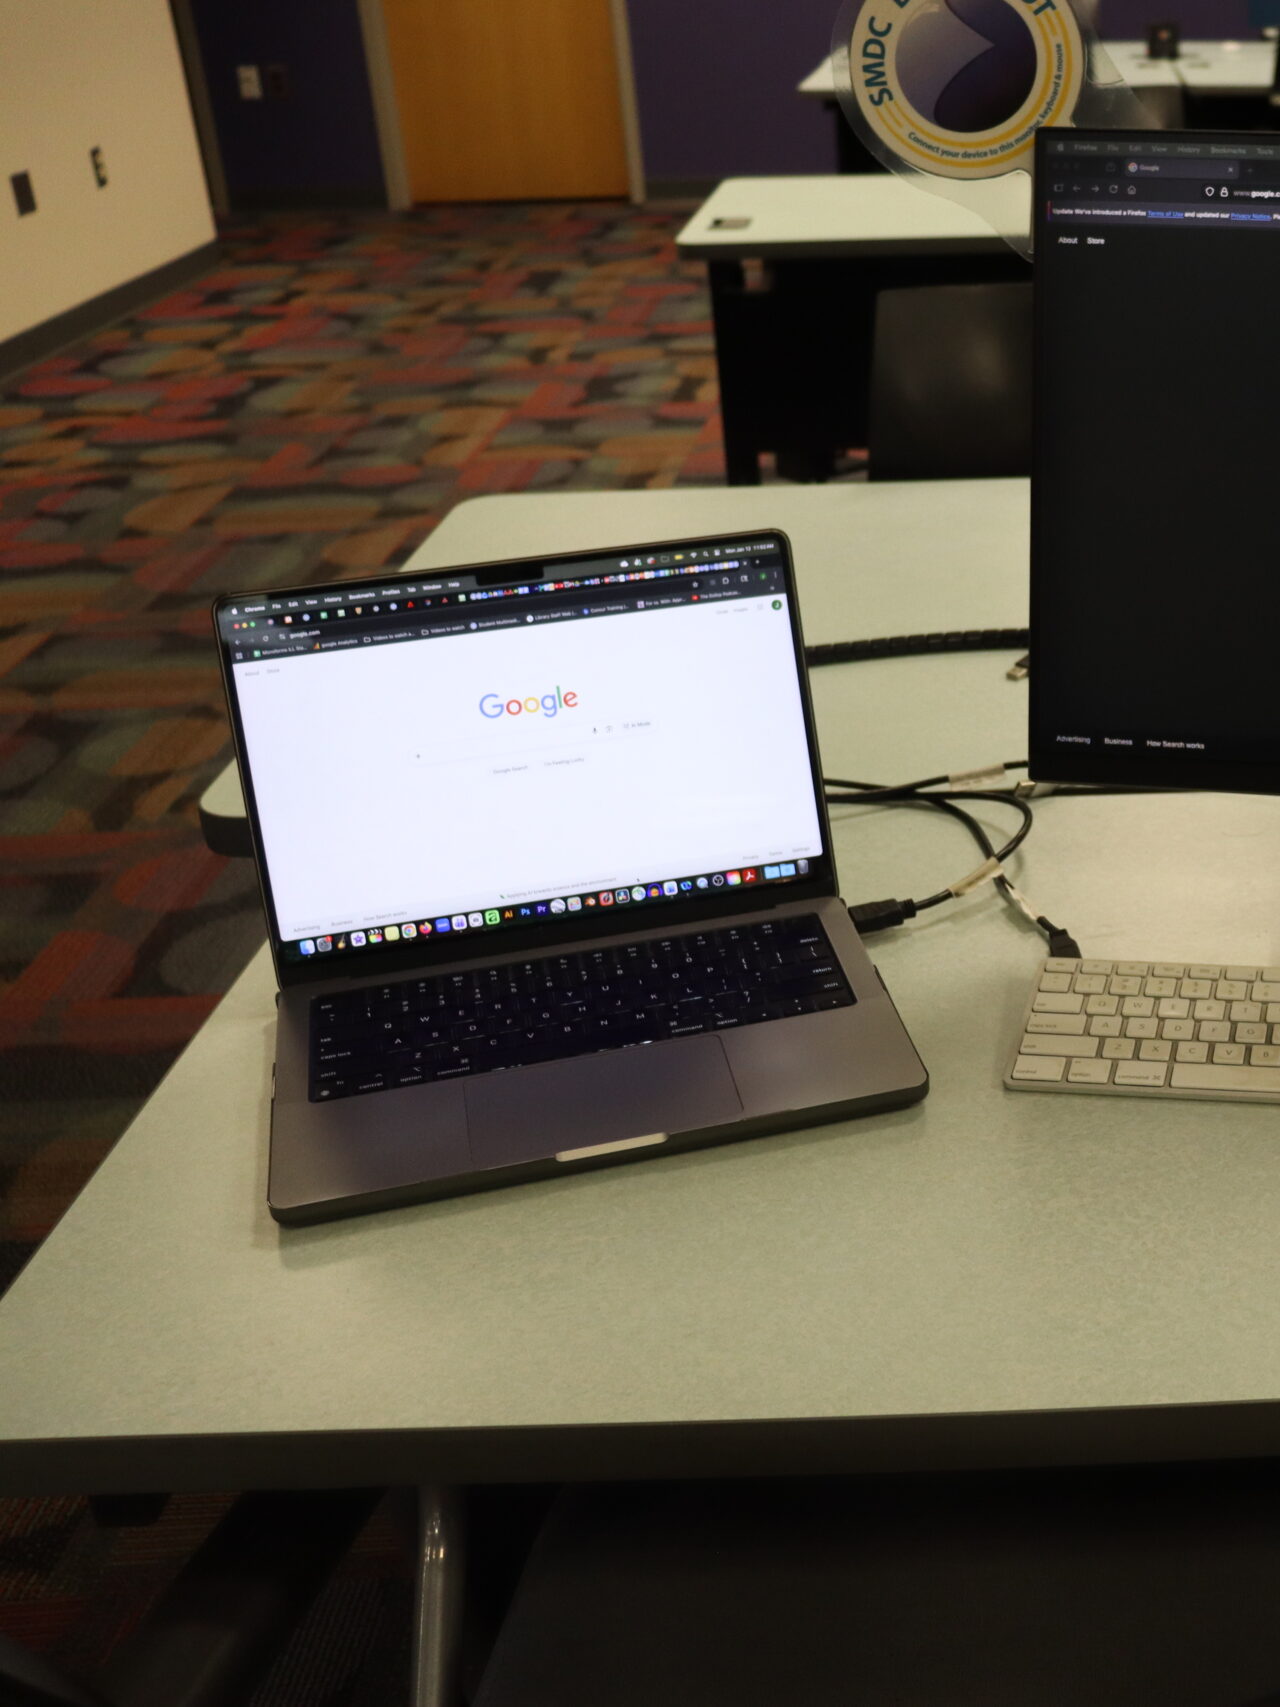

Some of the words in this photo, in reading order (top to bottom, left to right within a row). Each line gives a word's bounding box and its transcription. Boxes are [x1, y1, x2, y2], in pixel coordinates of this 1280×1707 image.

[862, 16, 894, 106] SMDC
[907, 131, 941, 154] Connect
[939, 148, 961, 160] your
[961, 149, 989, 160] device
[988, 146, 999, 156] to
[998, 138, 1015, 153] this
[1038, 81, 1062, 119] keyboard
[1055, 43, 1064, 73] mouse
[1151, 145, 1167, 153] View
[1177, 146, 1201, 155] History
[1211, 146, 1247, 156] Bookmarks
[1256, 148, 1274, 156] Tools
[1092, 208, 1122, 216] introduced
[1196, 211, 1220, 219] updated
[1057, 236, 1079, 245] About
[1086, 236, 1106, 245] Store
[324, 596, 342, 604] History
[348, 592, 376, 600] Bookmarks
[422, 583, 442, 592] Window
[289, 629, 321, 640] google.com
[479, 685, 578, 718] Google
[1056, 735, 1091, 745] Advertising
[1104, 737, 1133, 746] Business
[1146, 739, 1161, 747] How
[1162, 740, 1185, 749] Search
[1186, 742, 1205, 750] works
[419, 1015, 430, 1023] W
